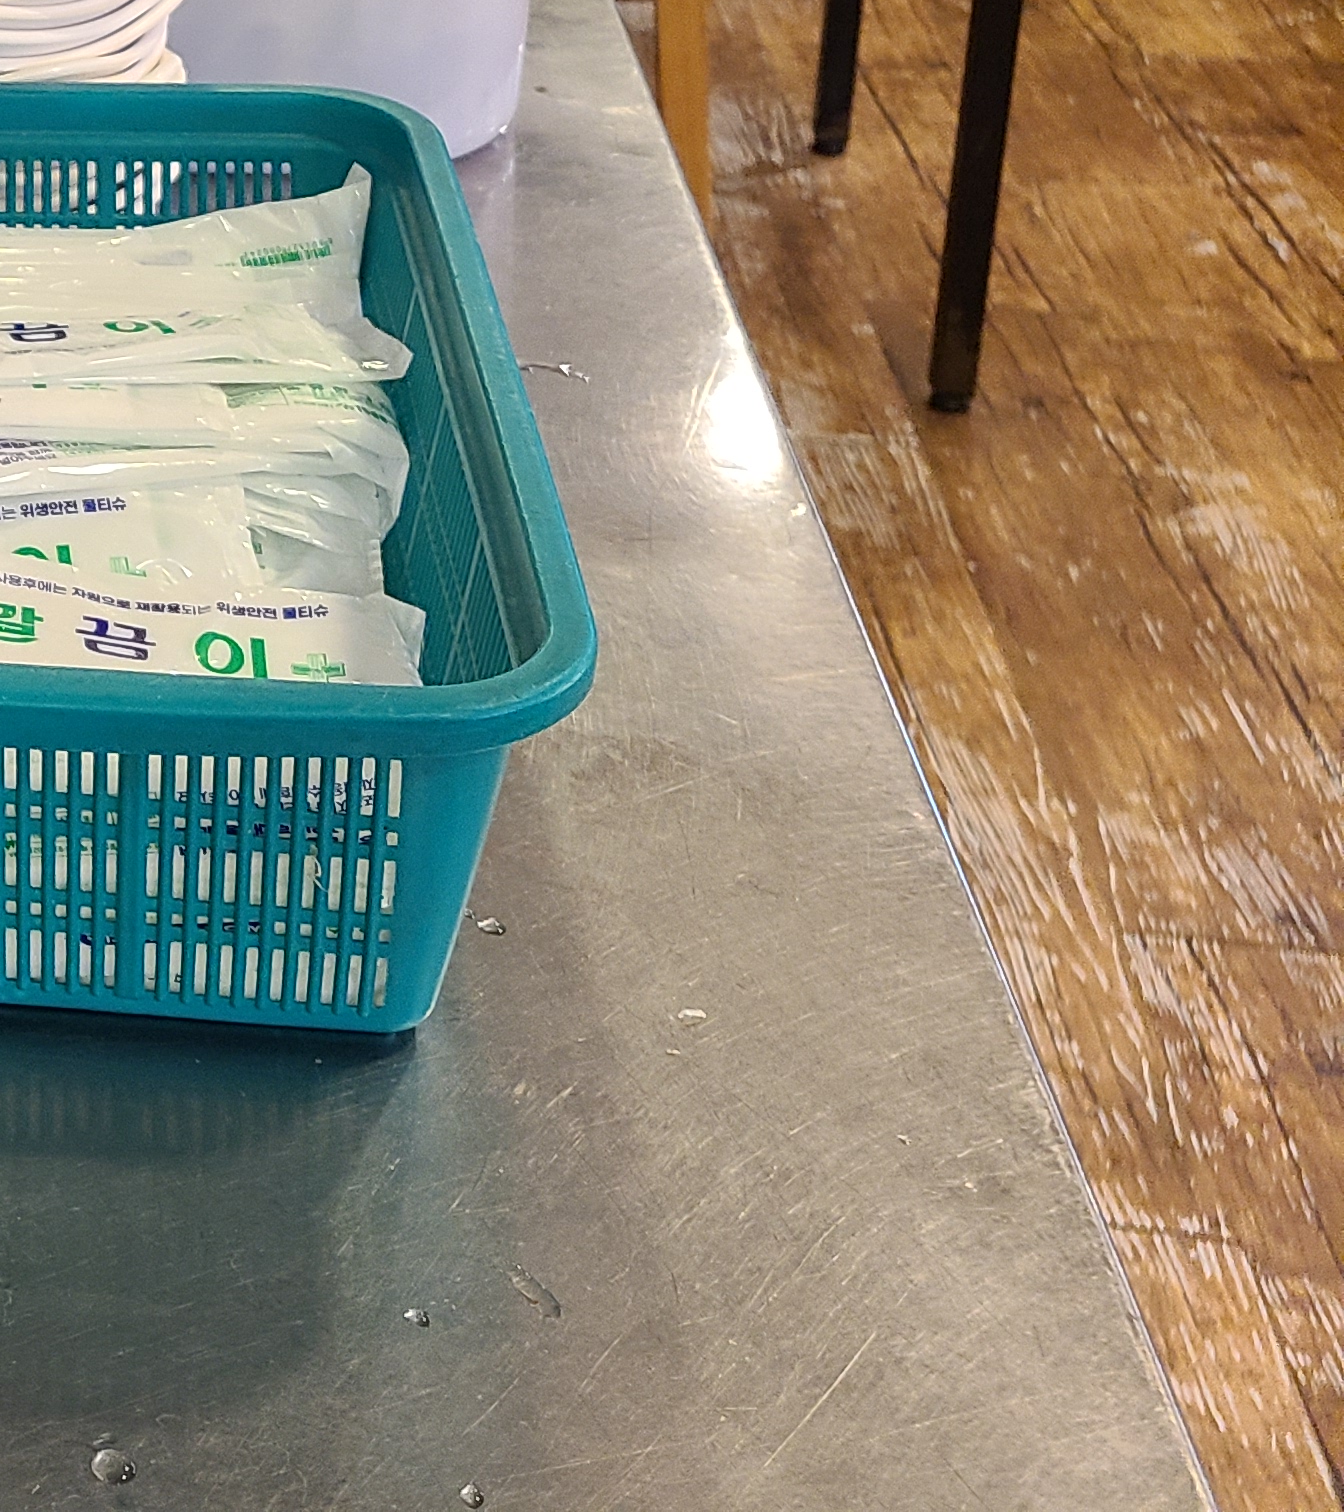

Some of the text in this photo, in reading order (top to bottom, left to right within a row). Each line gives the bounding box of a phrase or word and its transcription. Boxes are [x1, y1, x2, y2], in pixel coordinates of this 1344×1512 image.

[20, 500, 78, 518] 위생안전
[82, 496, 127, 512] 물티슈
[216, 600, 278, 620] 위생안전
[282, 602, 329, 619] 물티슈
